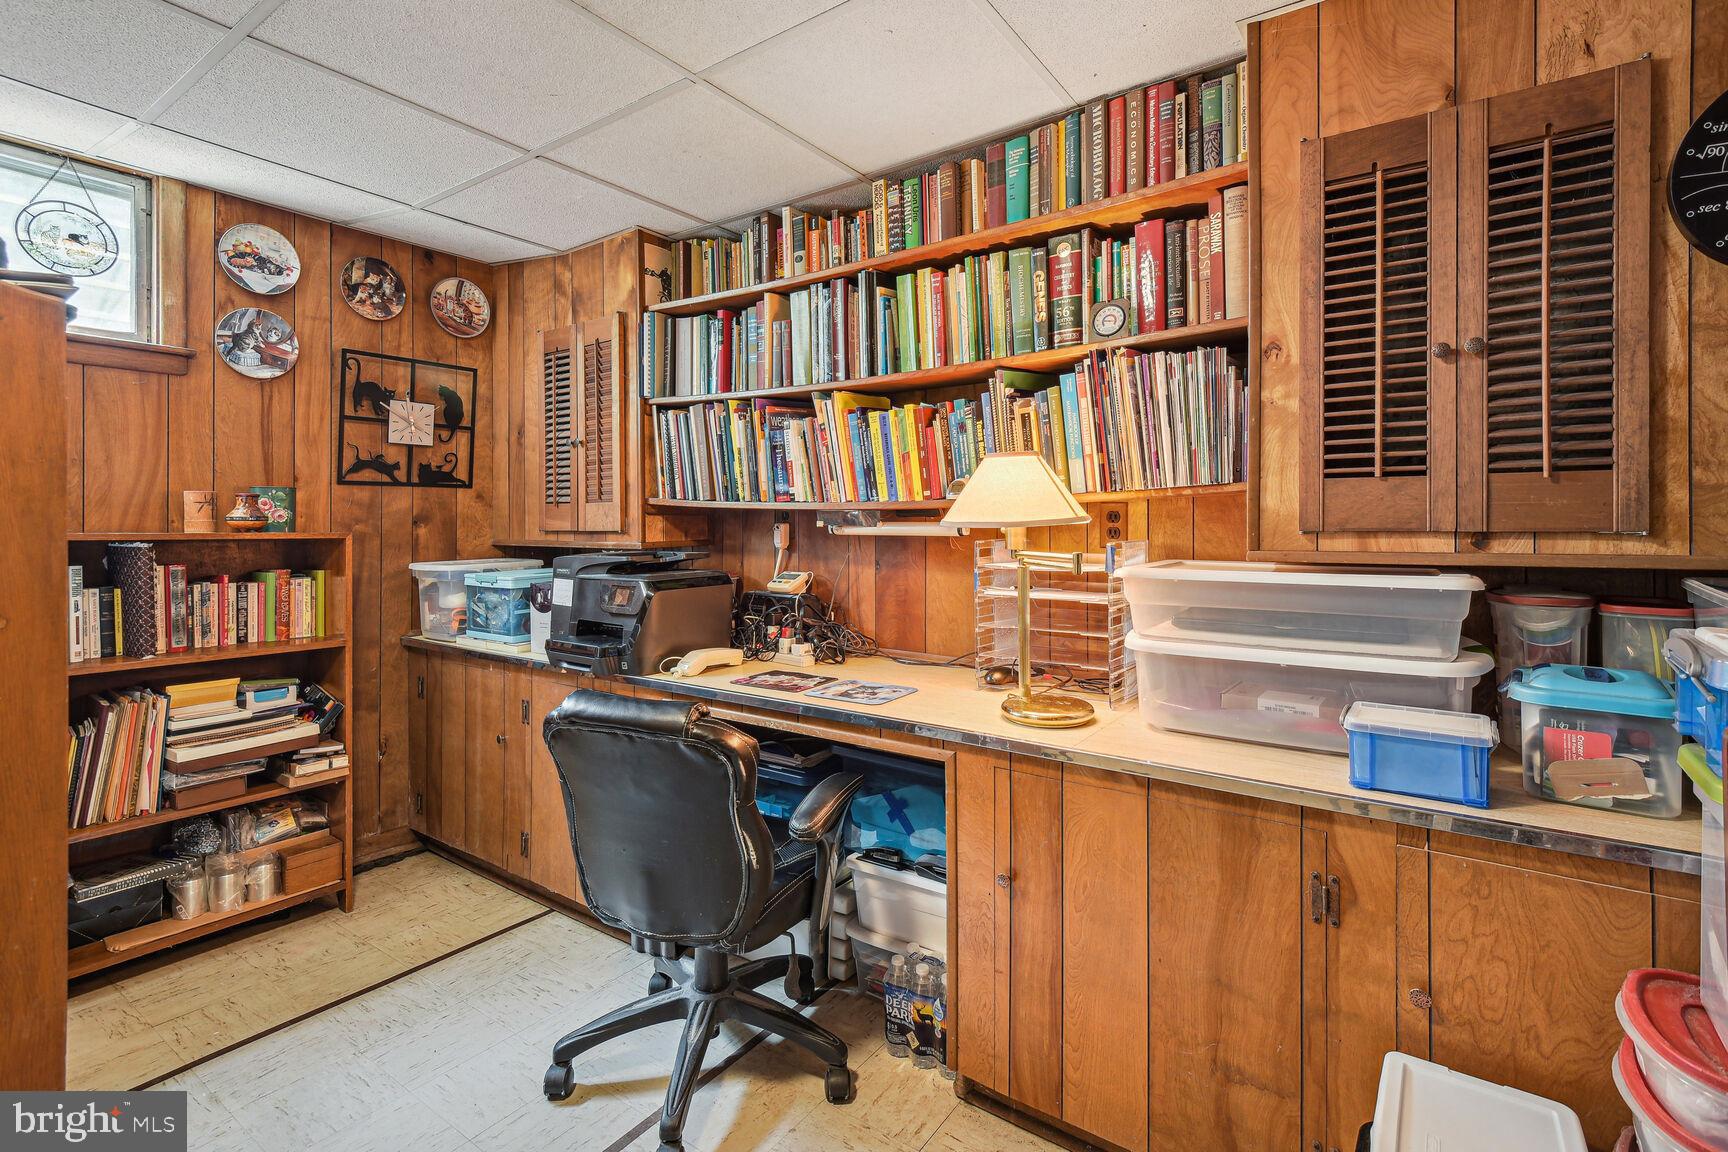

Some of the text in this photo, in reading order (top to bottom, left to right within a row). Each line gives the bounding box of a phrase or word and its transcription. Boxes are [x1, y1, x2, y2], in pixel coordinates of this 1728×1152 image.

[1176, 101, 1184, 150] POPULATION
[1092, 104, 1104, 201] MICROBIOLOG
[904, 185, 913, 235] TRINITY
[1697, 203, 1721, 213] sec
[1198, 226, 1211, 279] PROSE
[1210, 212, 1222, 255] SARAWAK
[1033, 270, 1047, 323] GENES
[775, 448, 785, 494] Thesaurus
[281, 601, 289, 622] LOVES
[1577, 734, 1585, 756] Cruzer
[886, 995, 914, 1014] DEER
[886, 1005, 915, 1024] PARK
